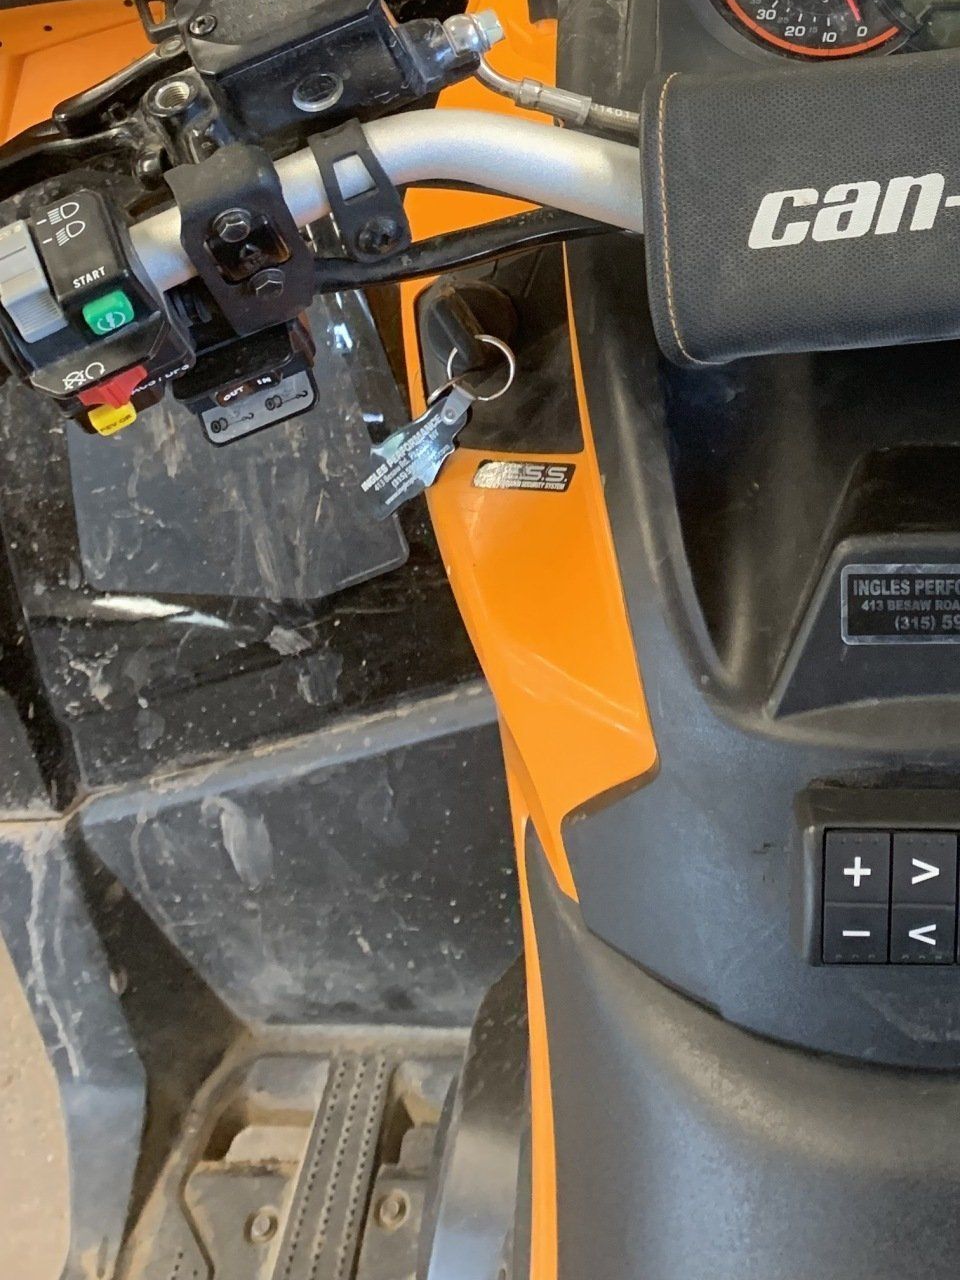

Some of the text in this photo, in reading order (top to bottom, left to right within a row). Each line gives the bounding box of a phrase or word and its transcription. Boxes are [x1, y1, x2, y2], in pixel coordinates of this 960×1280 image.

[756, 9, 777, 21] 30
[784, 25, 806, 37] 20
[822, 31, 838, 43] 10
[856, 26, 868, 38] 0
[72, 265, 106, 289] START
[223, 385, 244, 401] OUT
[360, 464, 388, 491] INGLES
[853, 579, 910, 596] INGLES
[861, 599, 884, 612] 413
[886, 599, 931, 612] BESAW
[894, 616, 936, 632] (315)
